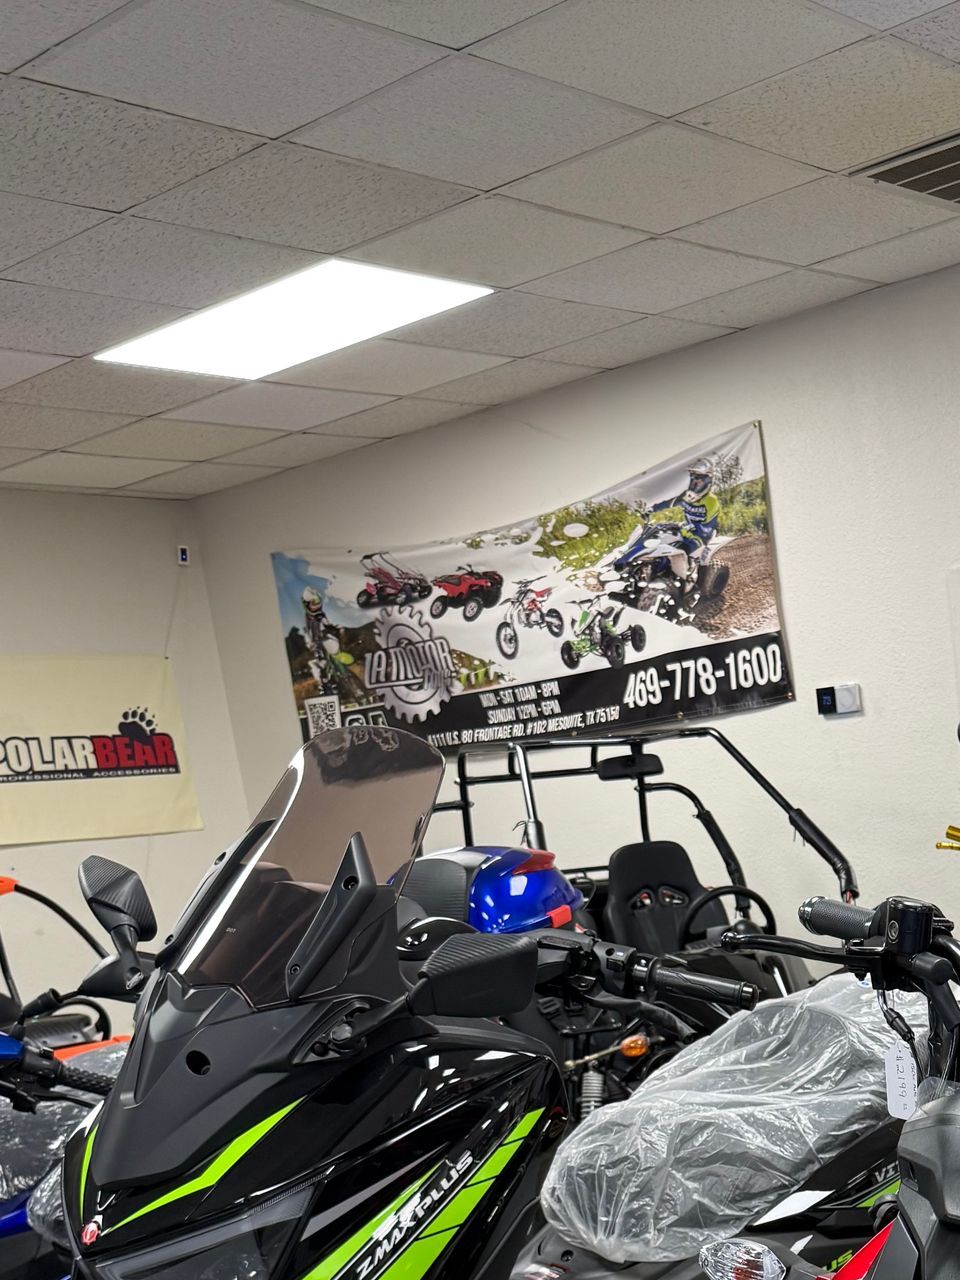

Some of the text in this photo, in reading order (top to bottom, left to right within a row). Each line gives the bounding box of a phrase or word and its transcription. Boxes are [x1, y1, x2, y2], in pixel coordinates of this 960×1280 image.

[389, 639, 456, 681] MOTOR
[623, 643, 783, 709] 469-778-1600
[479, 692, 499, 708] MON
[499, 689, 515, 705] SAT
[515, 685, 538, 702] 10AM
[541, 681, 561, 698] 8PM
[487, 707, 516, 725] SUNDAY
[516, 703, 539, 720] 12PM
[541, 699, 562, 716] 6PM
[461, 729, 473, 744] 80
[474, 725, 513, 742] FRONTAGE
[512, 723, 526, 737] RD.
[526, 719, 548, 736] #102
[547, 712, 586, 733] MESQUITE,
[585, 710, 597, 726] TX
[595, 704, 620, 724] 75150
[0, 767, 176, 783] ROFESSIONAL ACCESSORIES
[414, 1149, 474, 1218] PLUS
